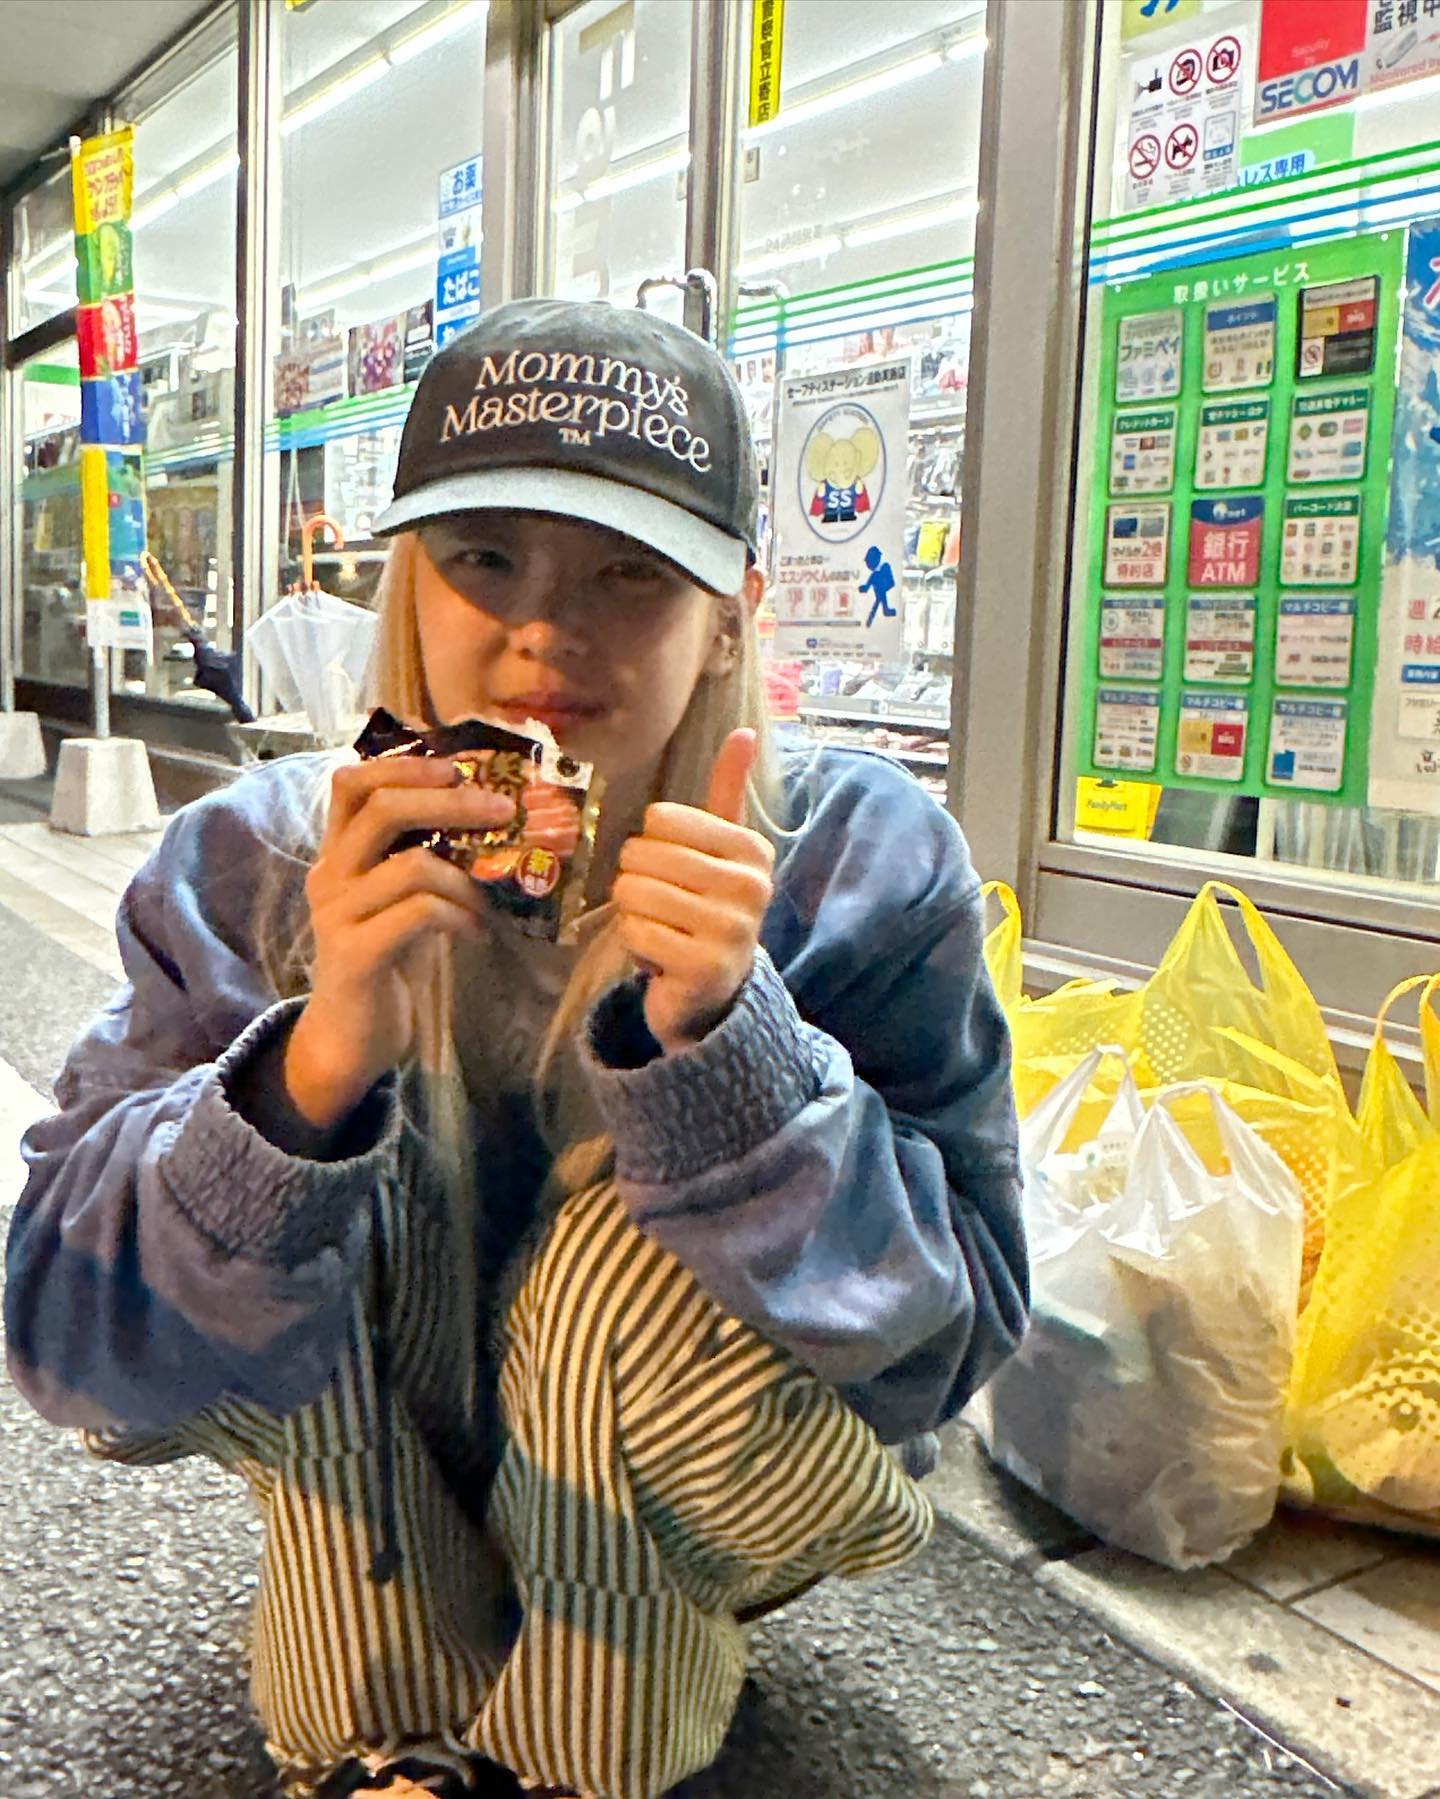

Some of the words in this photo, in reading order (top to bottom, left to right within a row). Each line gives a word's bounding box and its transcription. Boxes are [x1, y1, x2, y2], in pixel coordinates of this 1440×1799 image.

[1261, 58, 1360, 113] SECOM
[442, 269, 480, 305] たばこ
[1120, 335, 1182, 363] ファミペイ
[474, 349, 690, 417] Mommy's
[439, 386, 713, 473] Masterpiece
[827, 489, 852, 509] SS
[1203, 530, 1250, 560] 銀行
[1200, 561, 1247, 583] ATM
